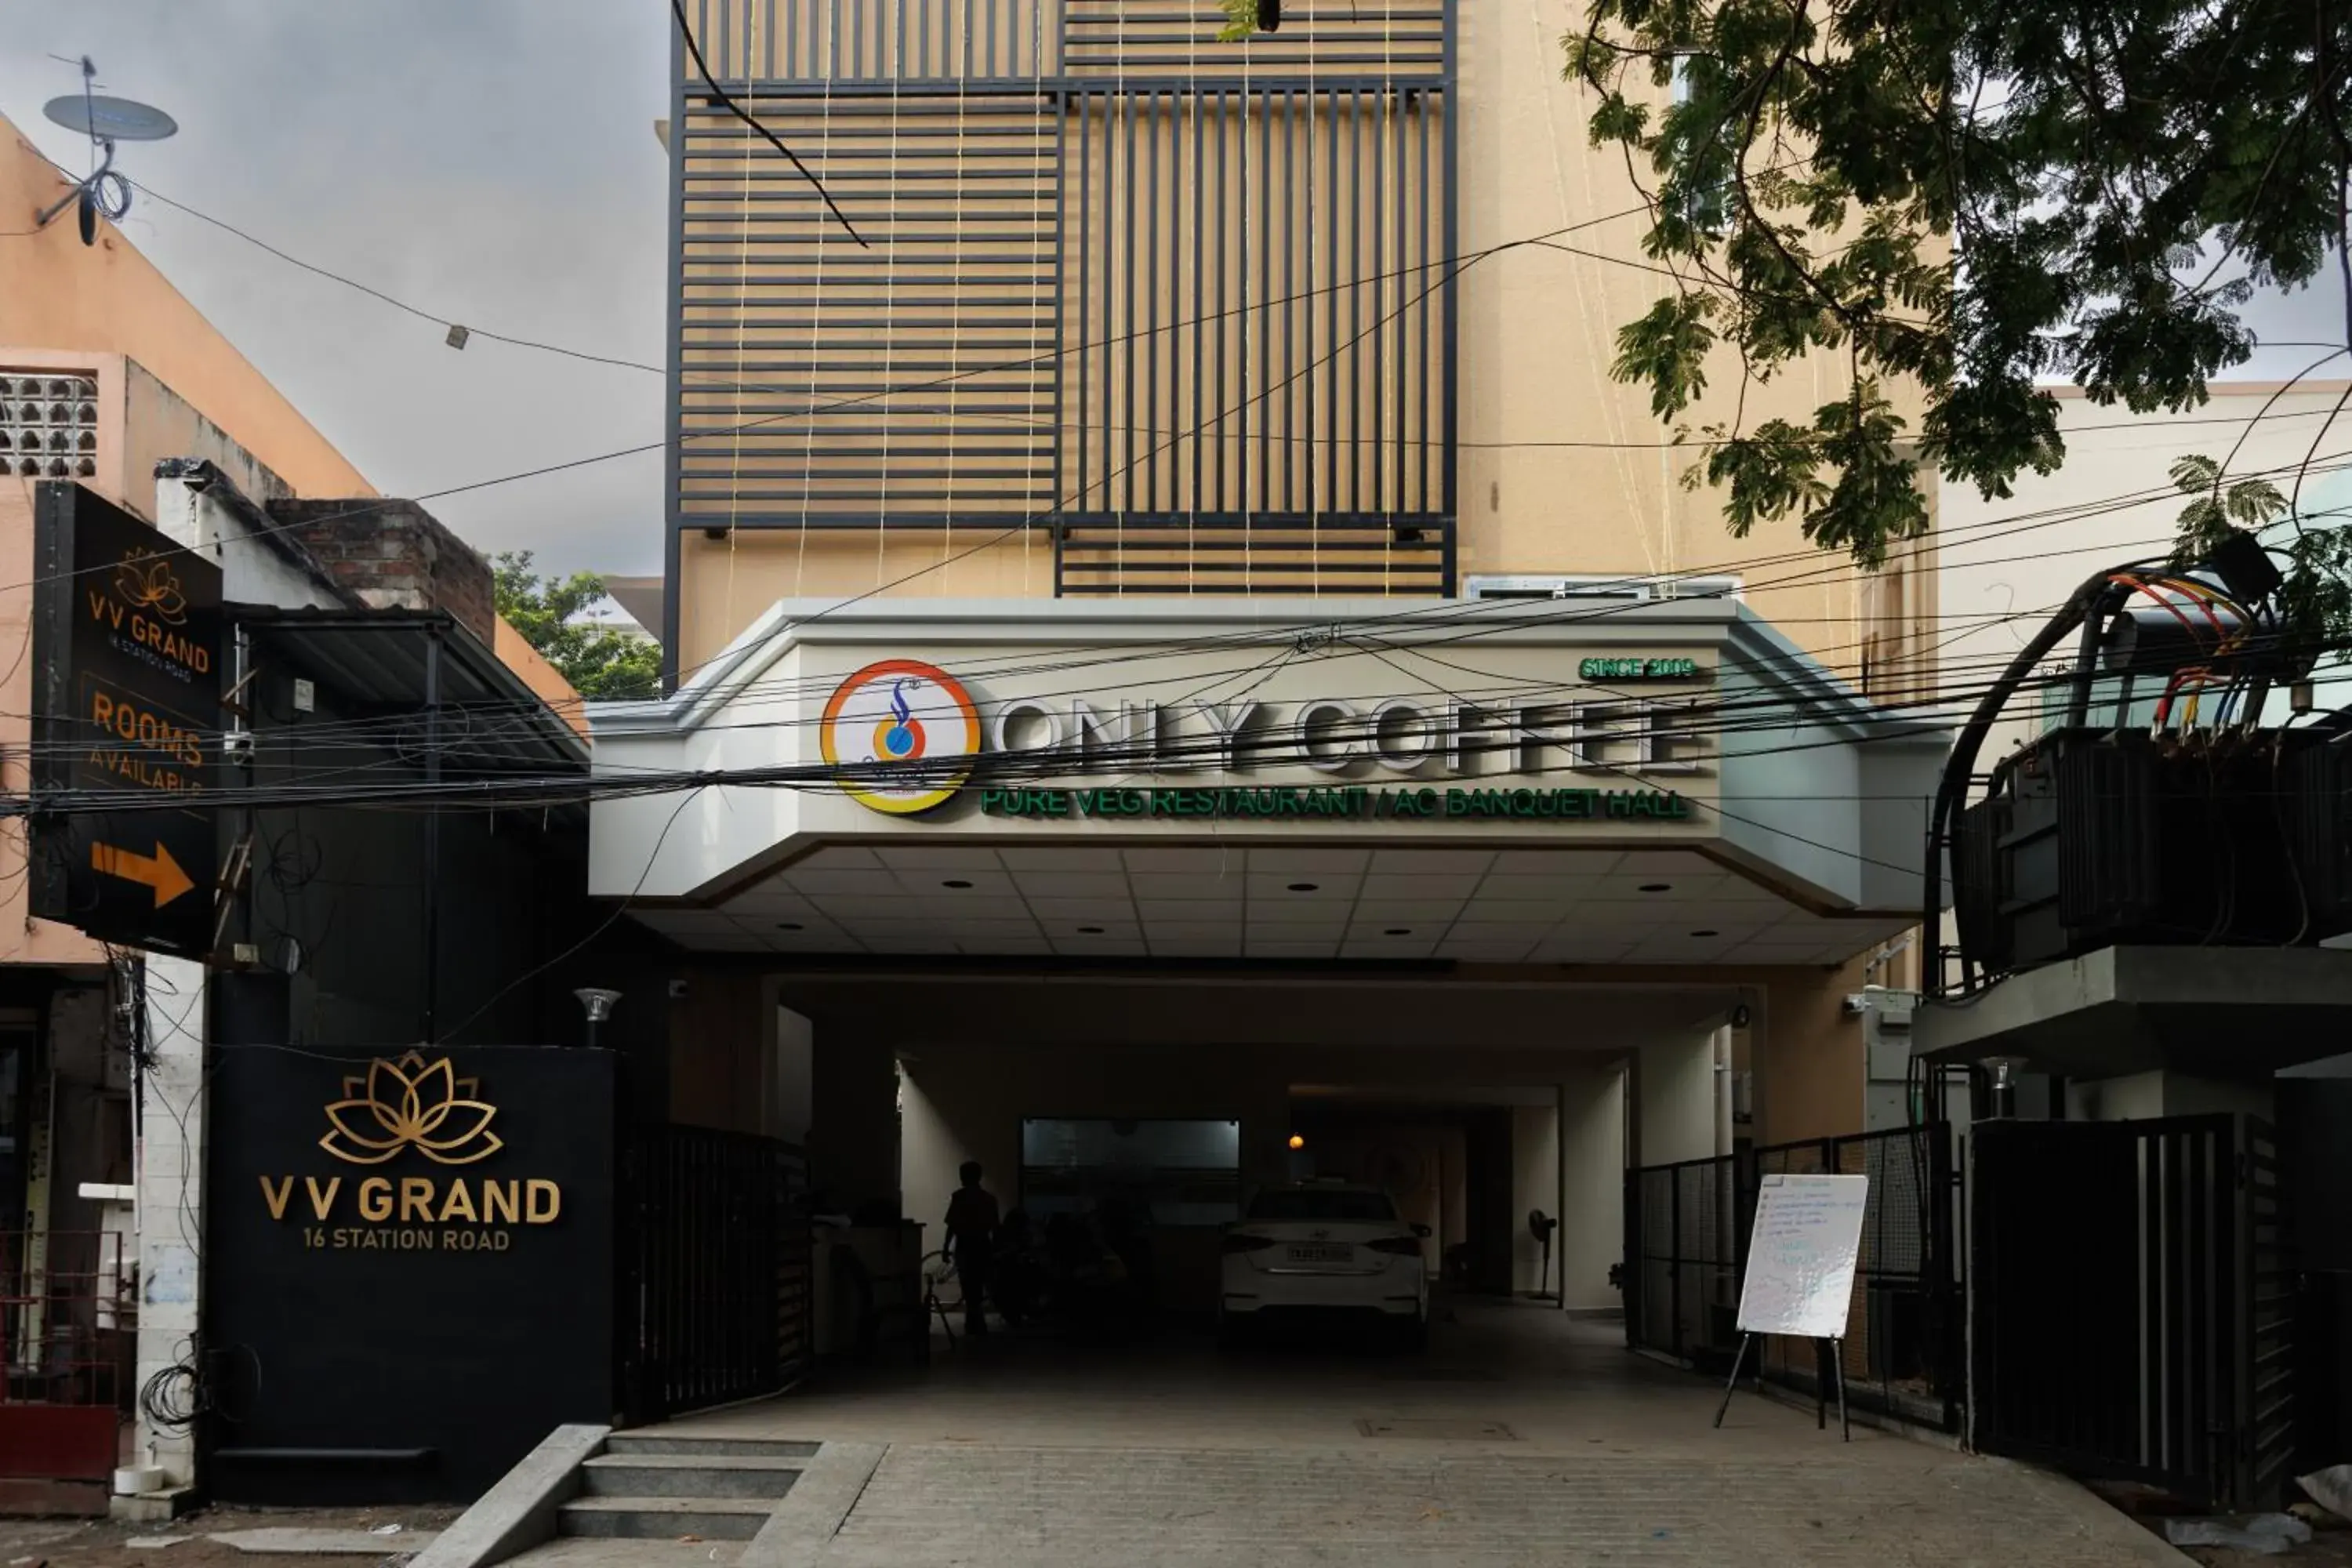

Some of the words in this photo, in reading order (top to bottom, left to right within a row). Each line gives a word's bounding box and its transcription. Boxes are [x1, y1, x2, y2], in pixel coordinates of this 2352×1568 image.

[132, 614, 209, 673] GRAND
[1580, 658, 1645, 677] SINCE
[93, 690, 202, 768] ROOMS
[1293, 698, 1698, 771] COFFEE
[982, 786, 1068, 815] PURE
[1074, 787, 1142, 815] VEG
[1149, 787, 1368, 816] RESTAURANT
[1393, 788, 1439, 816] AC
[1446, 788, 1600, 817] BANQUET
[1607, 789, 1687, 817] HALL
[358, 1177, 561, 1223] GRAND
[304, 1227, 325, 1248] 16
[333, 1228, 434, 1250] STATION
[442, 1229, 510, 1250] ROAD
